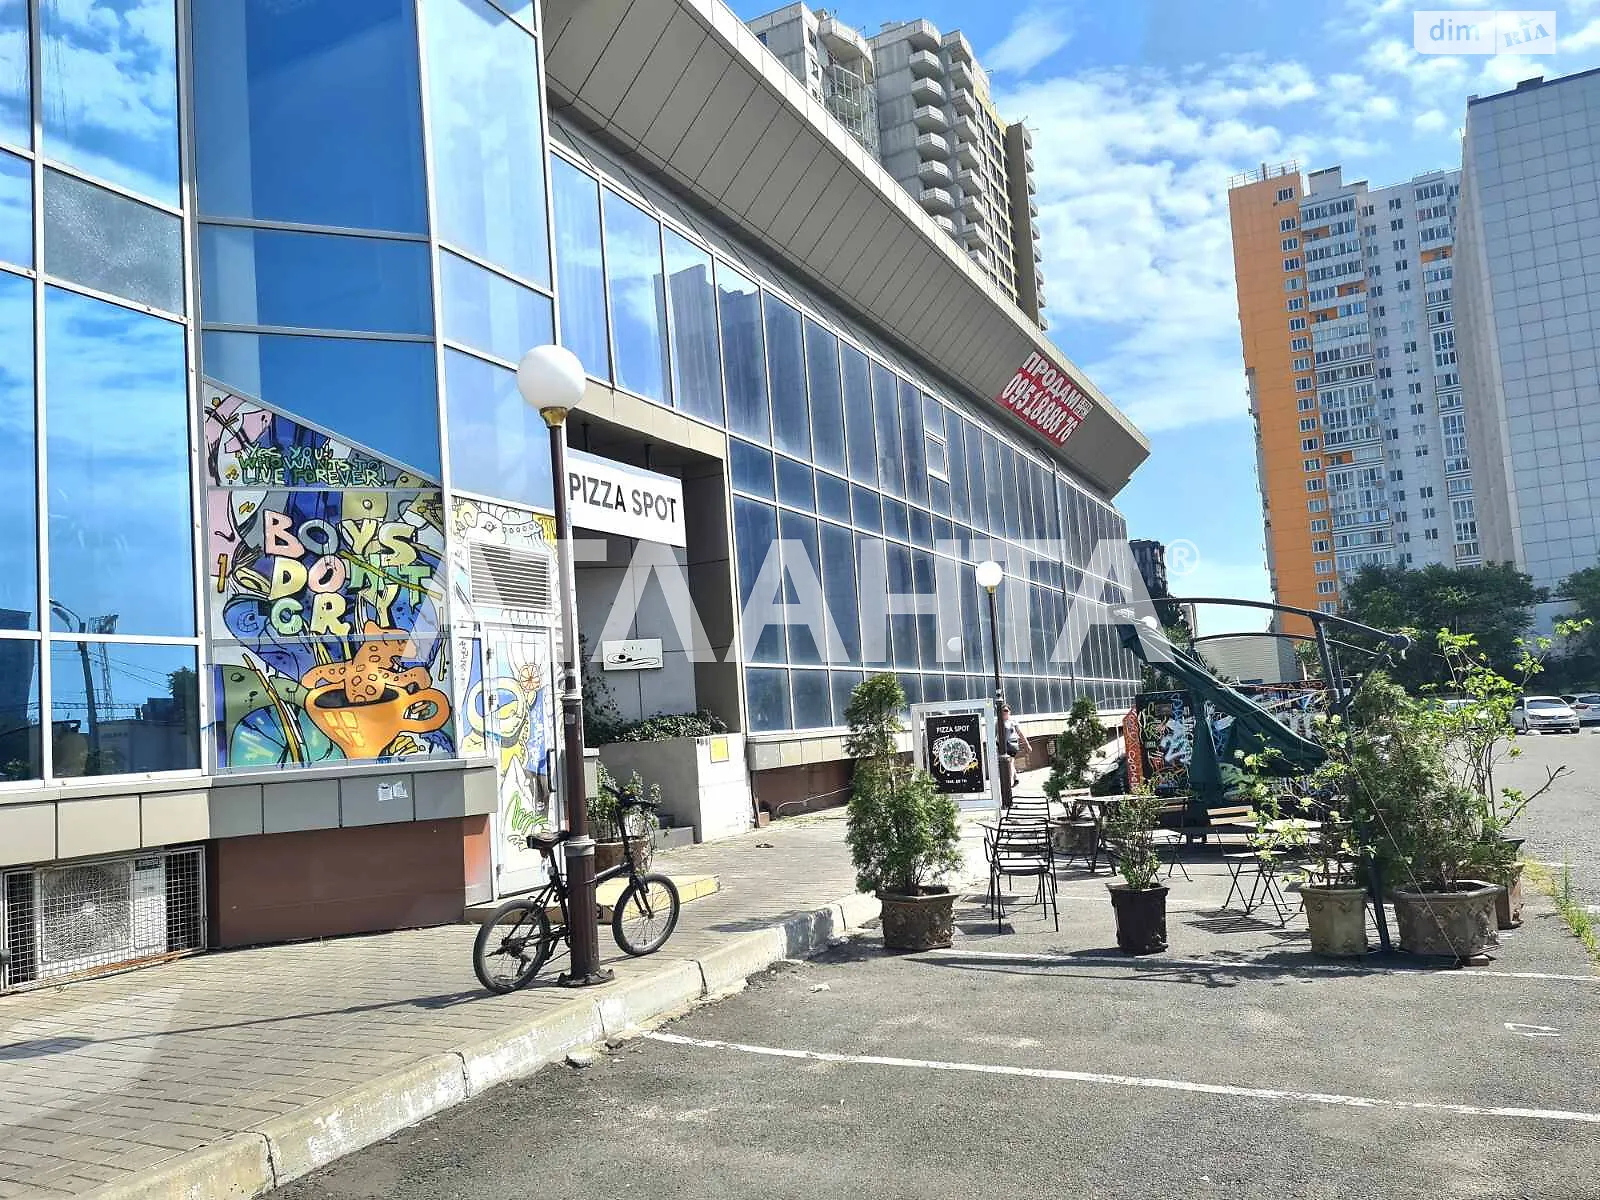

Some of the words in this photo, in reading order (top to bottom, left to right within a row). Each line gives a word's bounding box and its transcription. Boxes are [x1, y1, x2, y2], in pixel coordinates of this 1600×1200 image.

[1022, 352, 1082, 412] ПРОДАМ
[568, 472, 627, 513] PIZZA
[631, 489, 677, 523] SPOT
[264, 510, 417, 567] BOYS
[271, 584, 399, 636] CRY
[936, 726, 954, 734] PIZZA
